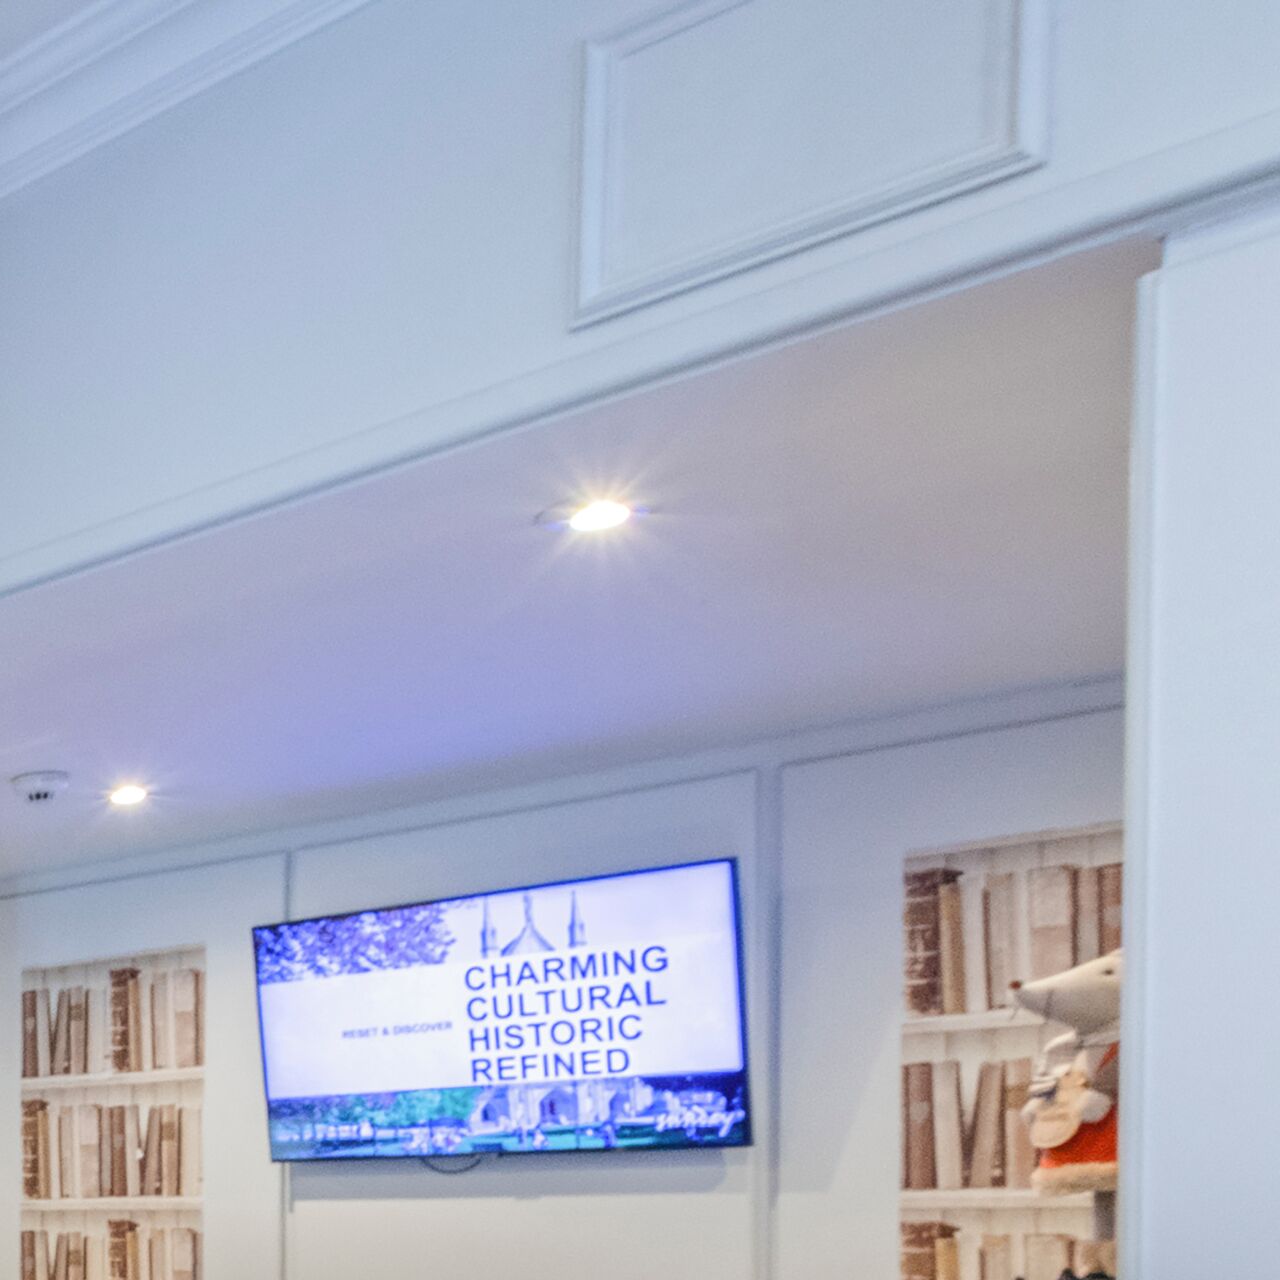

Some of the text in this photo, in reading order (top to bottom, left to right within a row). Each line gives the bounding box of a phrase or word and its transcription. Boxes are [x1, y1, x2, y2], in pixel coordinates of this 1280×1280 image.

[463, 944, 670, 992] CHARMING
[465, 980, 667, 1022] CULTURAL
[341, 1027, 379, 1039] RESET
[392, 1020, 453, 1036] DISCOVER
[467, 1013, 644, 1053] HISTORIC
[470, 1046, 631, 1082] REFINED
